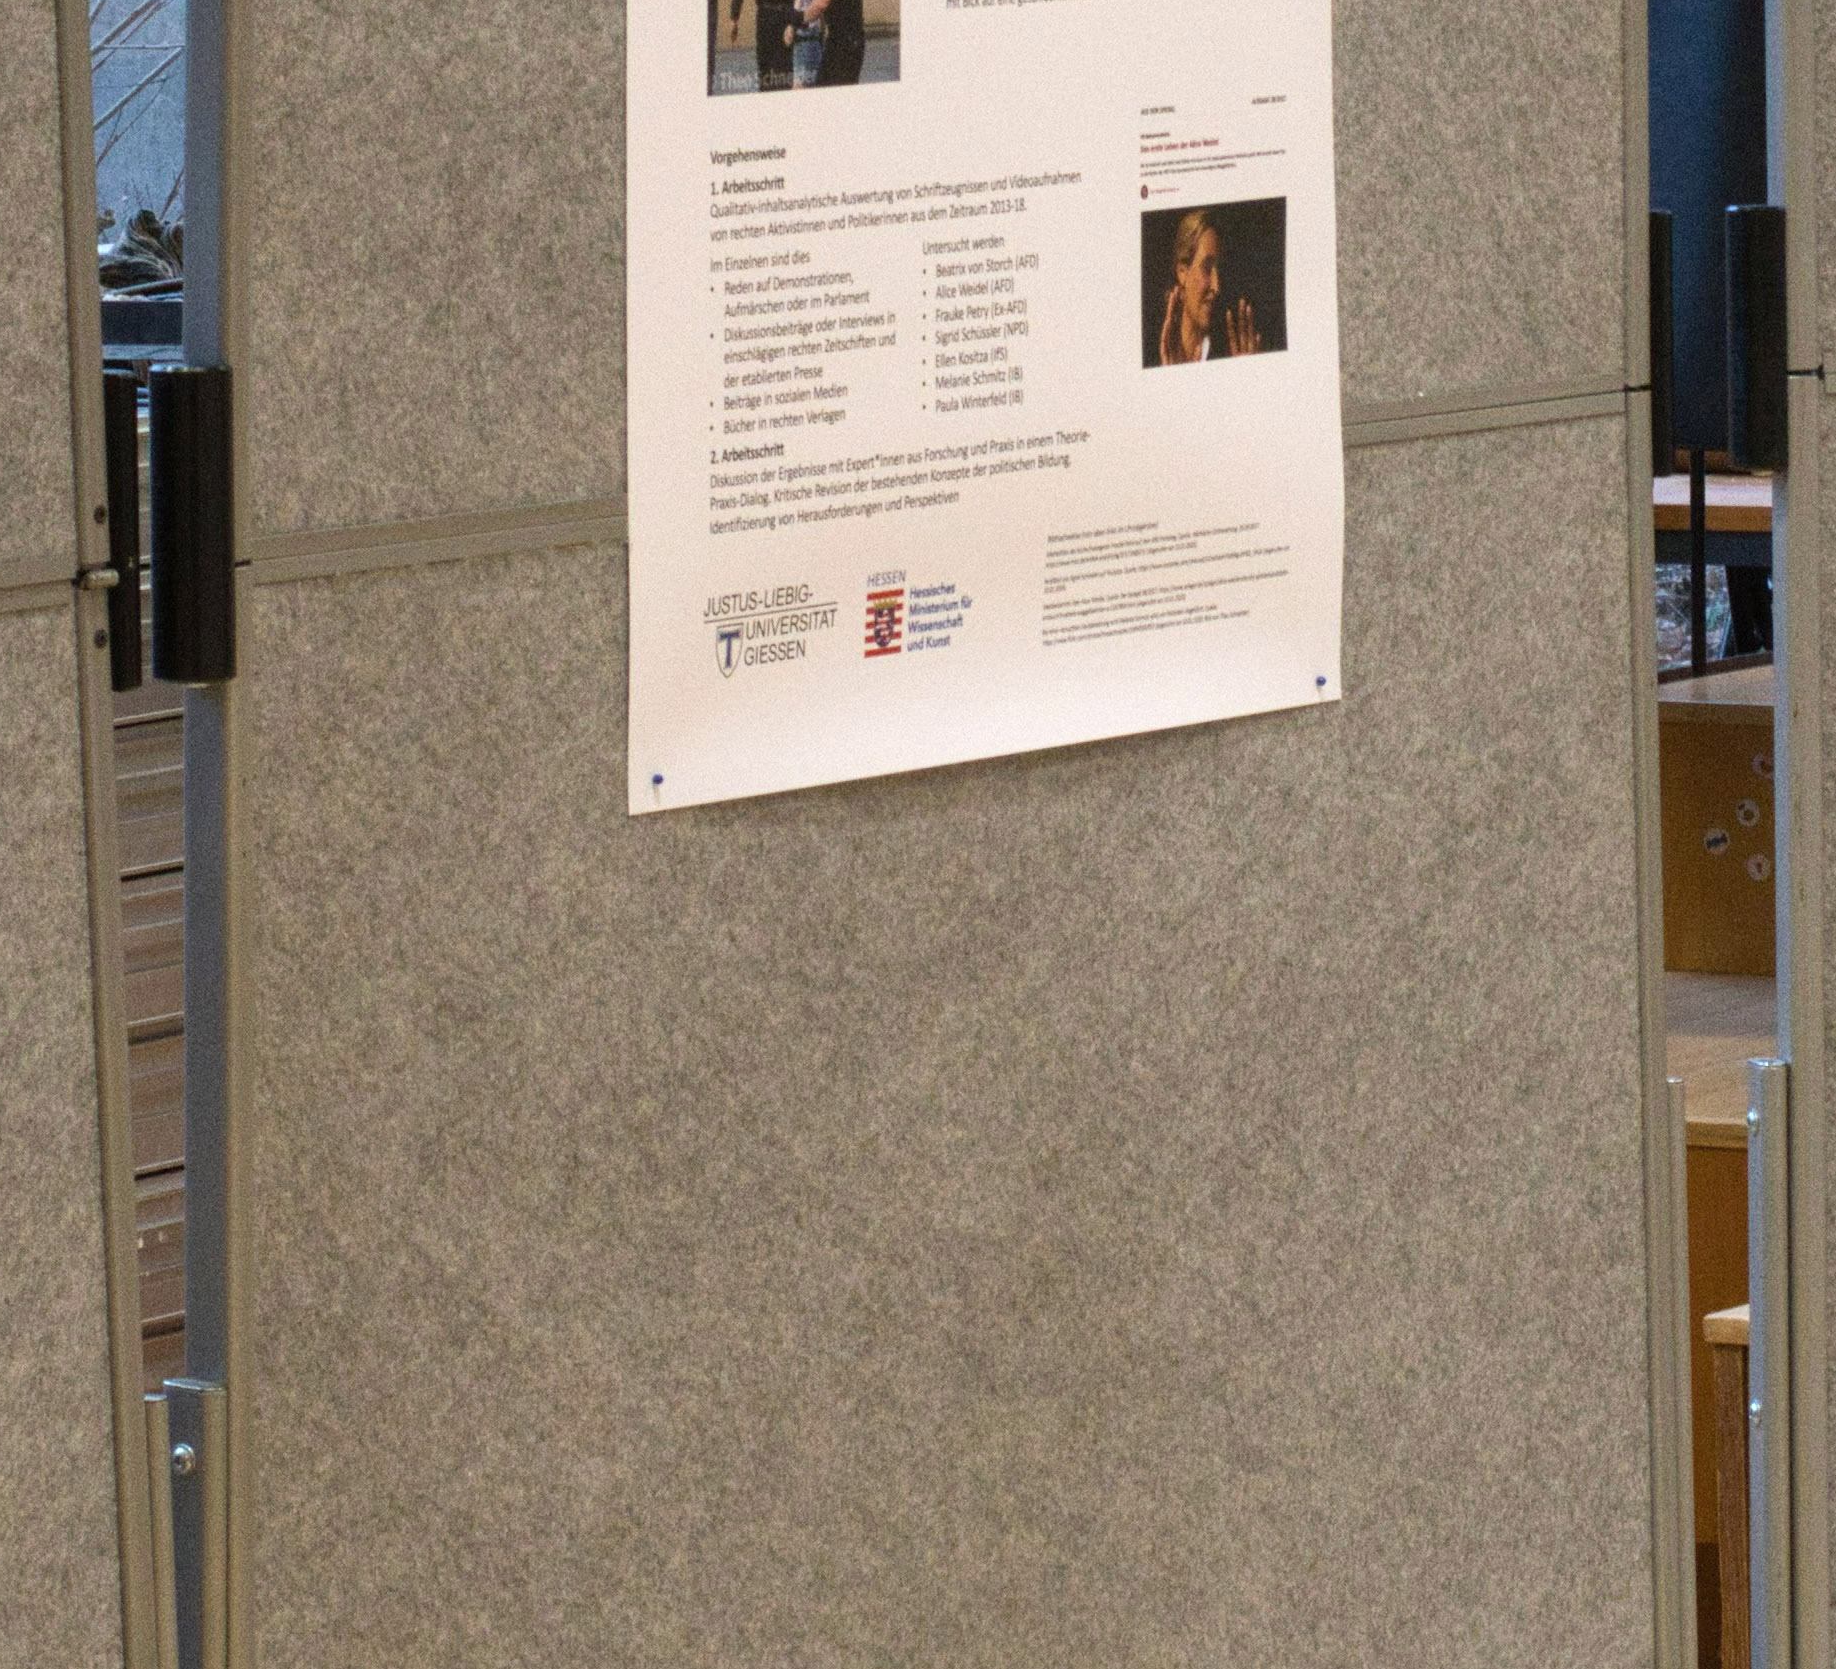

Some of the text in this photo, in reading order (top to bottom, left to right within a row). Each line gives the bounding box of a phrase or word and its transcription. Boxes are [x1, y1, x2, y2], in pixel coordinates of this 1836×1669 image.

[710, 147, 787, 167] Vorgehensweise
[721, 176, 785, 195] Arbeitsschritt
[703, 582, 814, 618] JUSTUS-LIEBIG-
[743, 639, 807, 667] GIESSEN
